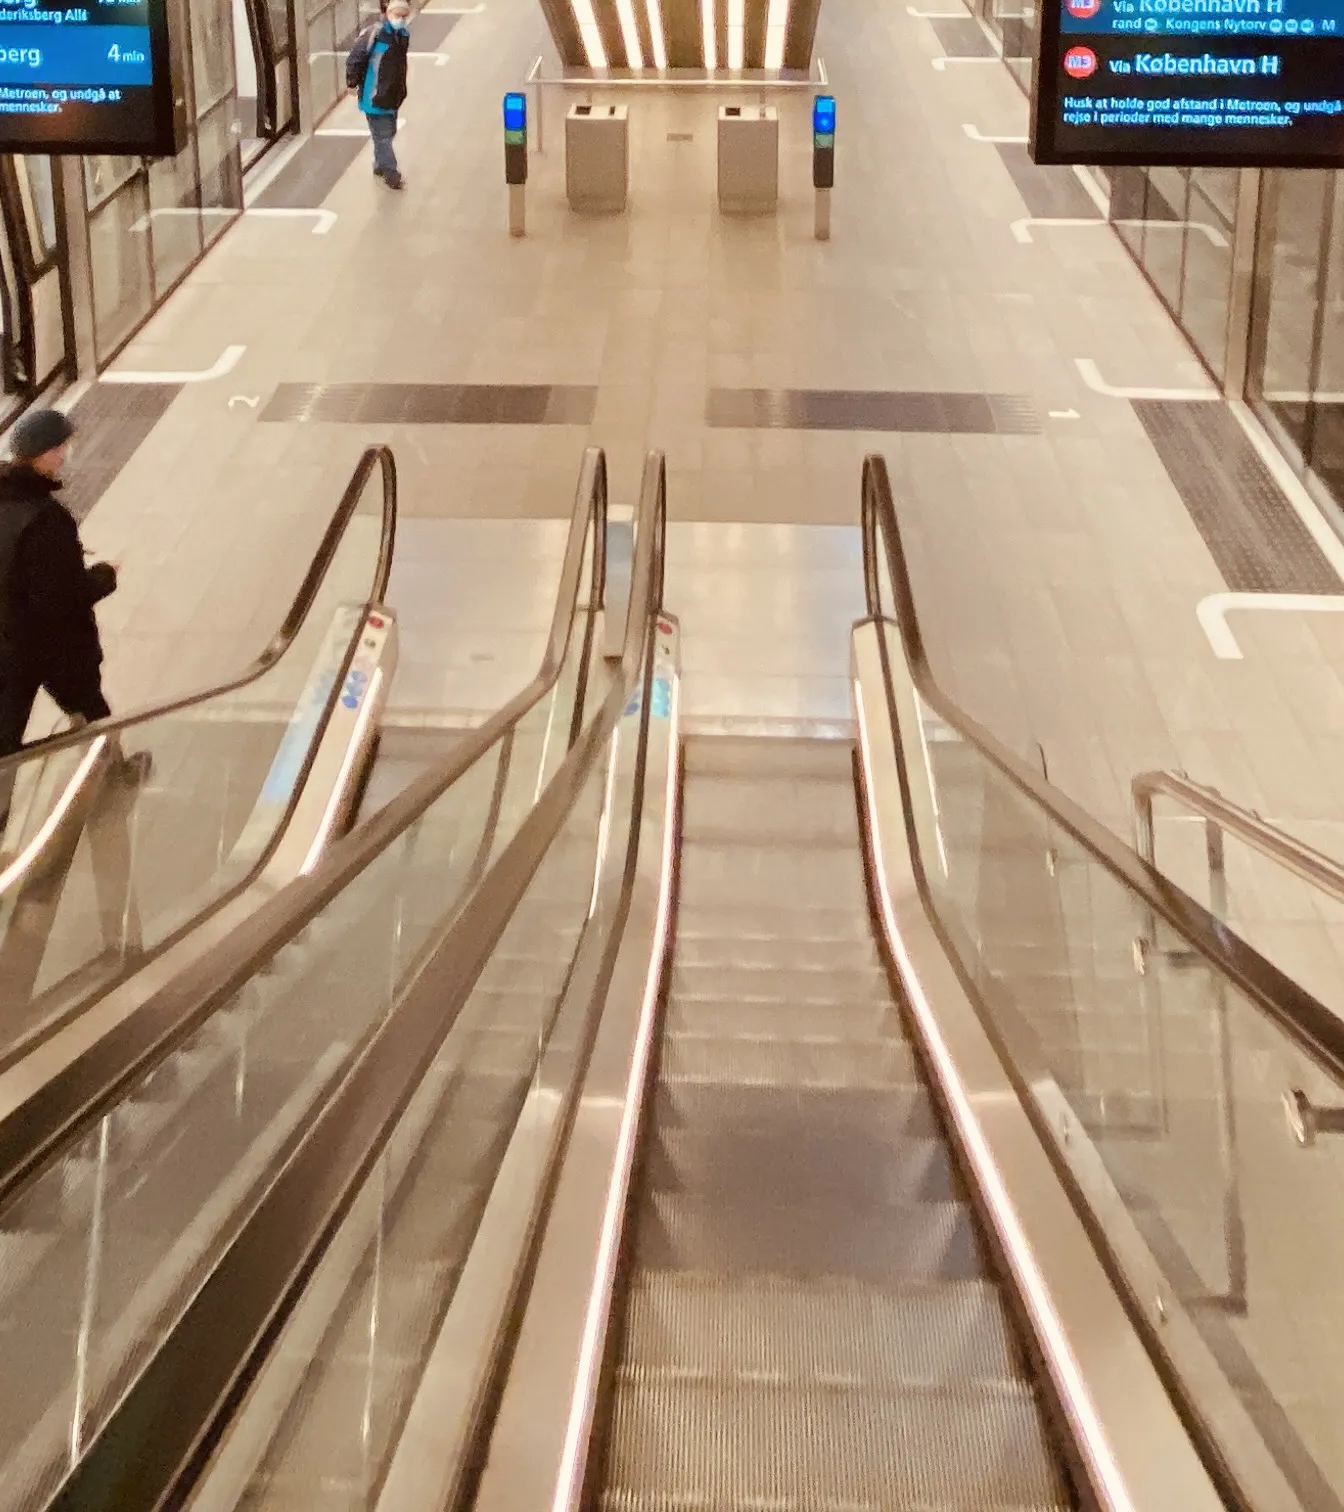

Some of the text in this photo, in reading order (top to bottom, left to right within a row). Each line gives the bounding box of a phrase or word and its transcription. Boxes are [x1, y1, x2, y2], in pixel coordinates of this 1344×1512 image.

[1112, 17, 1142, 29] rand
[1165, 18, 1221, 32] Kongens
[1223, 18, 1267, 33] Nytorv
[107, 43, 121, 62] 4
[122, 50, 145, 62] min
[1135, 53, 1256, 74] København
[1260, 55, 1279, 74] H
[1064, 96, 1093, 108] Husk
[1095, 97, 1108, 109] at
[1110, 97, 1144, 109] holde
[1146, 98, 1171, 111] god
[1172, 97, 1217, 110] afstand
[1100, 111, 1151, 125] perioder
[1152, 112, 1179, 124] med
[1181, 113, 1223, 126] mange
